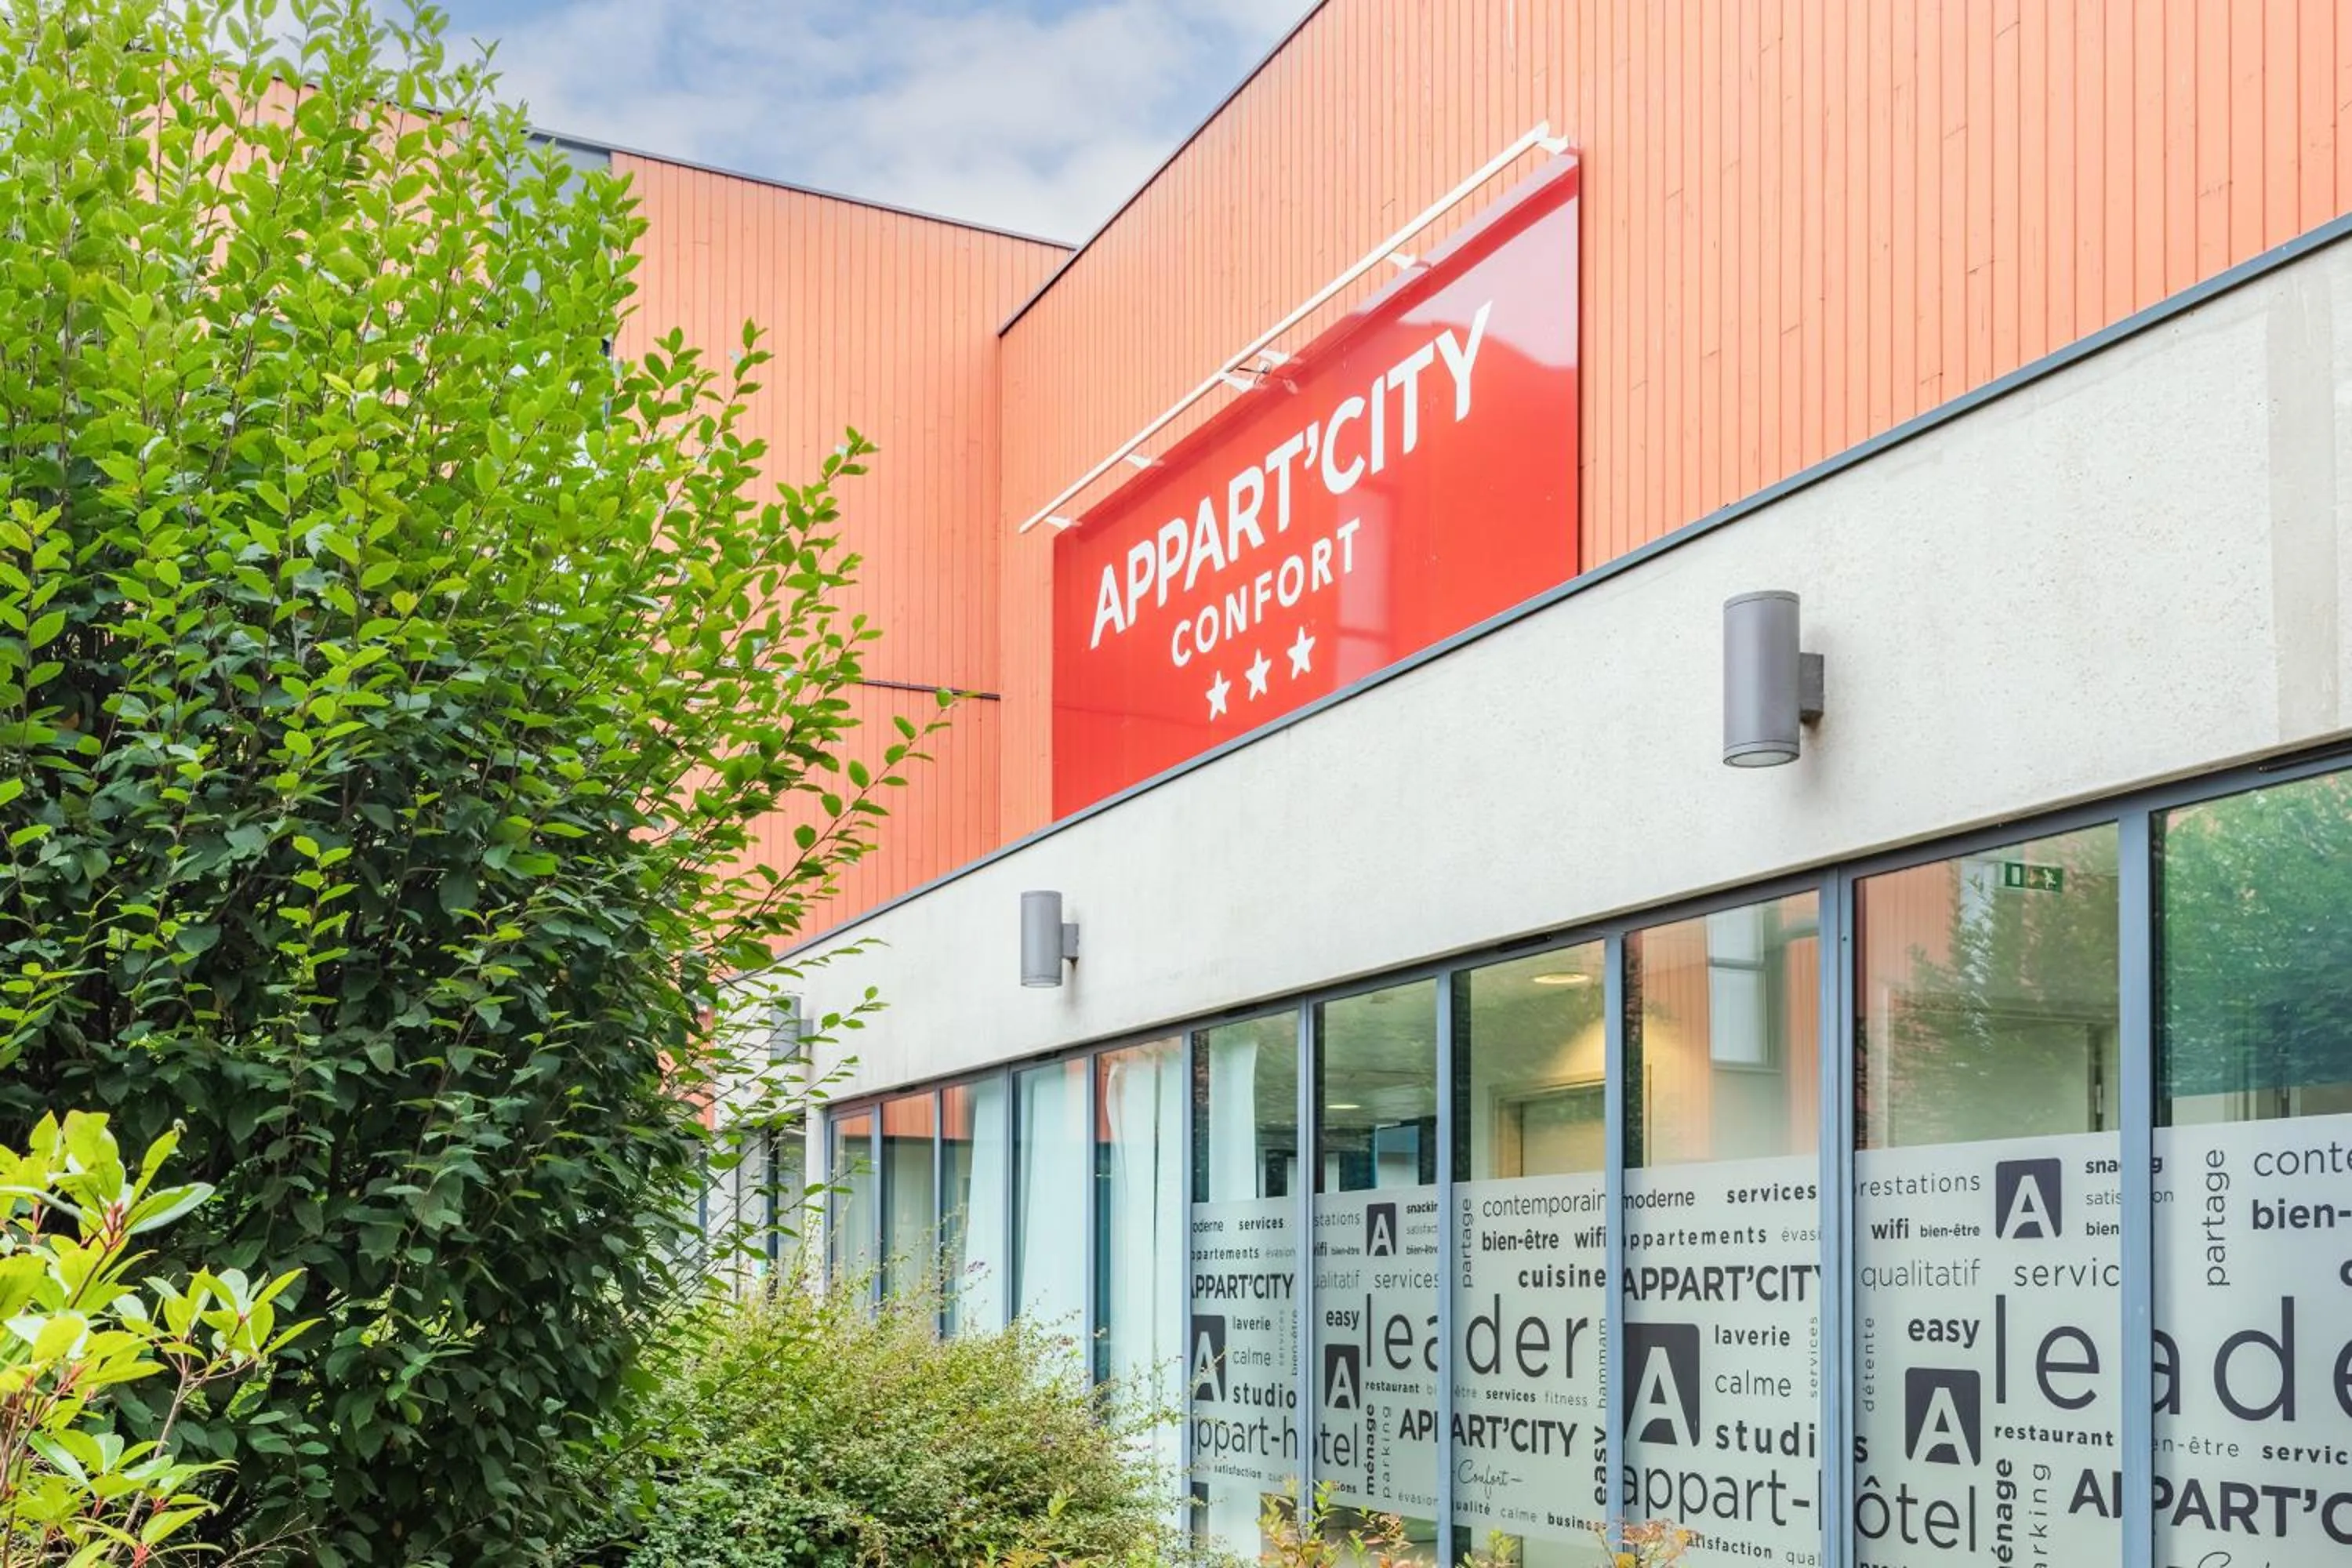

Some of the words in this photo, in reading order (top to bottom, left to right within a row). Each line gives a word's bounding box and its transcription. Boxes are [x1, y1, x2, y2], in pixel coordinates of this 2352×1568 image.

[1090, 300, 1494, 650] APPART'CITY
[1171, 518, 1360, 668] CONFORT
[2254, 1142, 2352, 1176] cont
[1623, 1189, 1695, 1210] moderne
[1726, 1183, 1817, 1203] services
[1855, 1174, 1980, 1197] restations
[1192, 1218, 1224, 1233] oderne
[1239, 1216, 1284, 1231] services
[1314, 1213, 1360, 1227] stations
[2201, 1149, 2230, 1287] partage
[2252, 1199, 2352, 1230] bien-
[1482, 1229, 1559, 1251] bien-être
[1575, 1226, 1606, 1249] wifi
[1871, 1218, 1909, 1240] wifi
[1920, 1223, 1980, 1238] bien-être
[1192, 1246, 1259, 1262] ppartements
[1461, 1198, 1474, 1288] partage
[1314, 1270, 1360, 1290] ualitatif
[1518, 1264, 1606, 1288] cuisine
[1861, 1258, 1980, 1291] qualitatif
[2013, 1258, 2120, 1287] servic
[1232, 1316, 1271, 1330] laverie
[1326, 1310, 1360, 1330] easy
[1907, 1317, 1980, 1349] easy
[1715, 1324, 1791, 1346] laverie
[1232, 1346, 1271, 1367] calme
[1809, 1316, 1818, 1399] services
[1862, 1317, 1875, 1412] détente
[1233, 1381, 1298, 1409] studio
[1366, 1380, 1420, 1394] restaurant
[1486, 1388, 1537, 1402] services
[1544, 1392, 1588, 1406] fitness
[1715, 1370, 1792, 1397] calme
[1365, 1404, 1377, 1495] ménage
[1381, 1406, 1392, 1498] parking
[1994, 1425, 2115, 1446] restaurant
[2153, 1436, 2239, 1457] en-être
[1452, 1500, 1490, 1515] ualité
[1501, 1507, 1537, 1523] calme
[1991, 1458, 2017, 1568] énage
[1686, 1533, 1773, 1559] atisfaction
